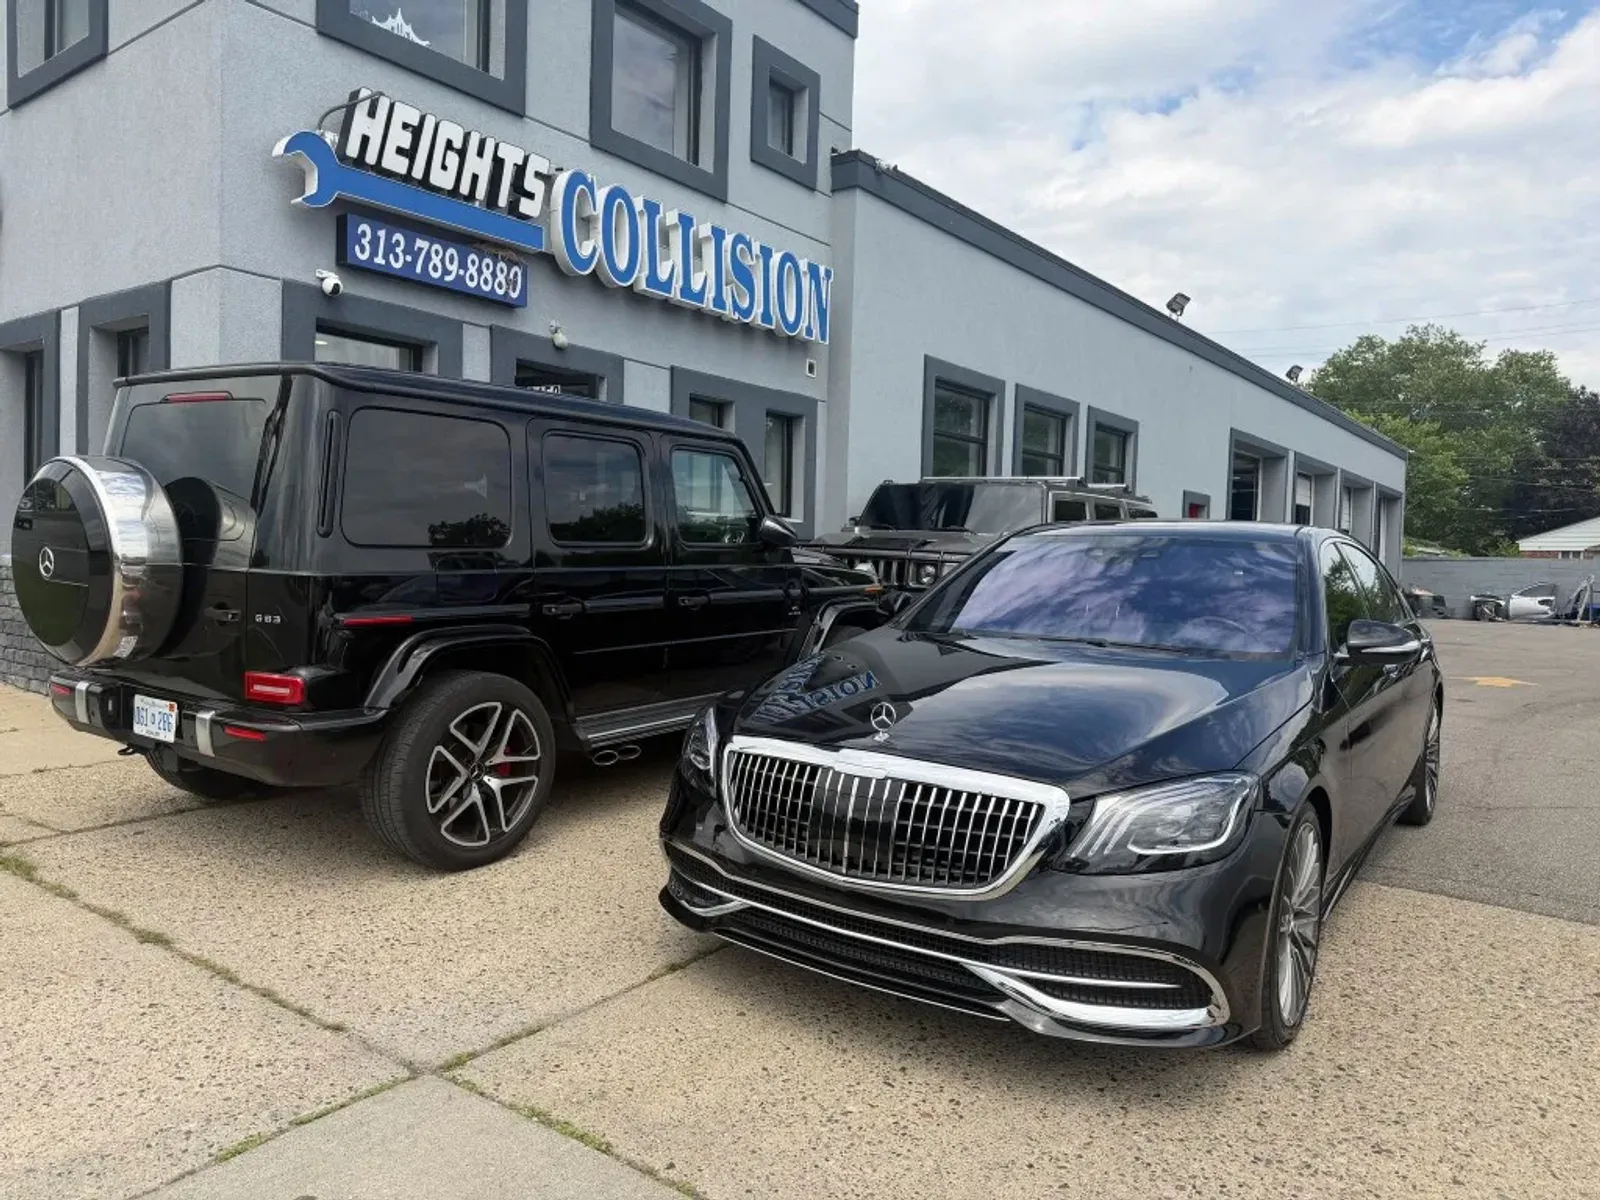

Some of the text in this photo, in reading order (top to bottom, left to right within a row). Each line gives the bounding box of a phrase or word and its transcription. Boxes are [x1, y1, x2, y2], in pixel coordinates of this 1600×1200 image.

[345, 87, 550, 218] HEIGHTS
[354, 223, 522, 299] 313-789-8880
[551, 168, 834, 345] COLLISION
